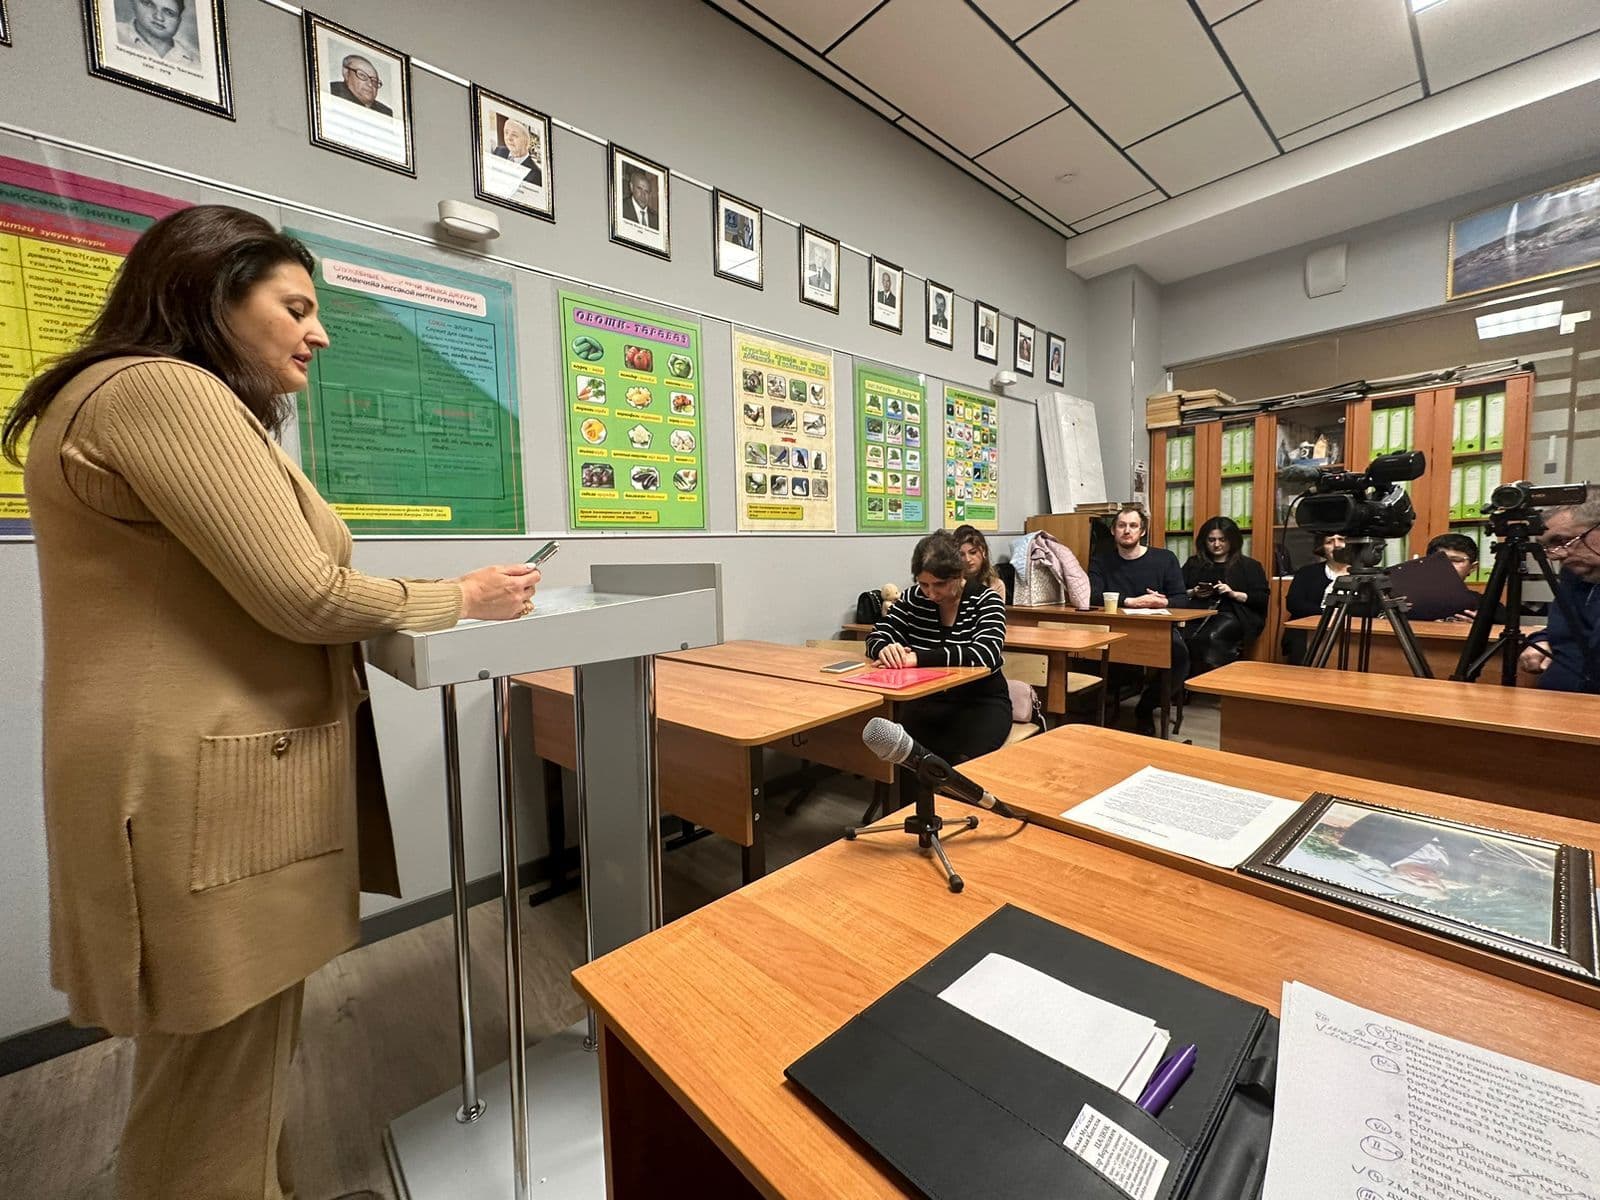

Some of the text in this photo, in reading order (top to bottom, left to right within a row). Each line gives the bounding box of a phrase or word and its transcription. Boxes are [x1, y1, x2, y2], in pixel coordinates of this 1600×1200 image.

[1384, 1025, 1423, 1044] Список
[1428, 1041, 1508, 1074] выступающих
[1409, 1118, 1457, 1144] Полина
[1411, 1157, 1452, 1181] Елена
